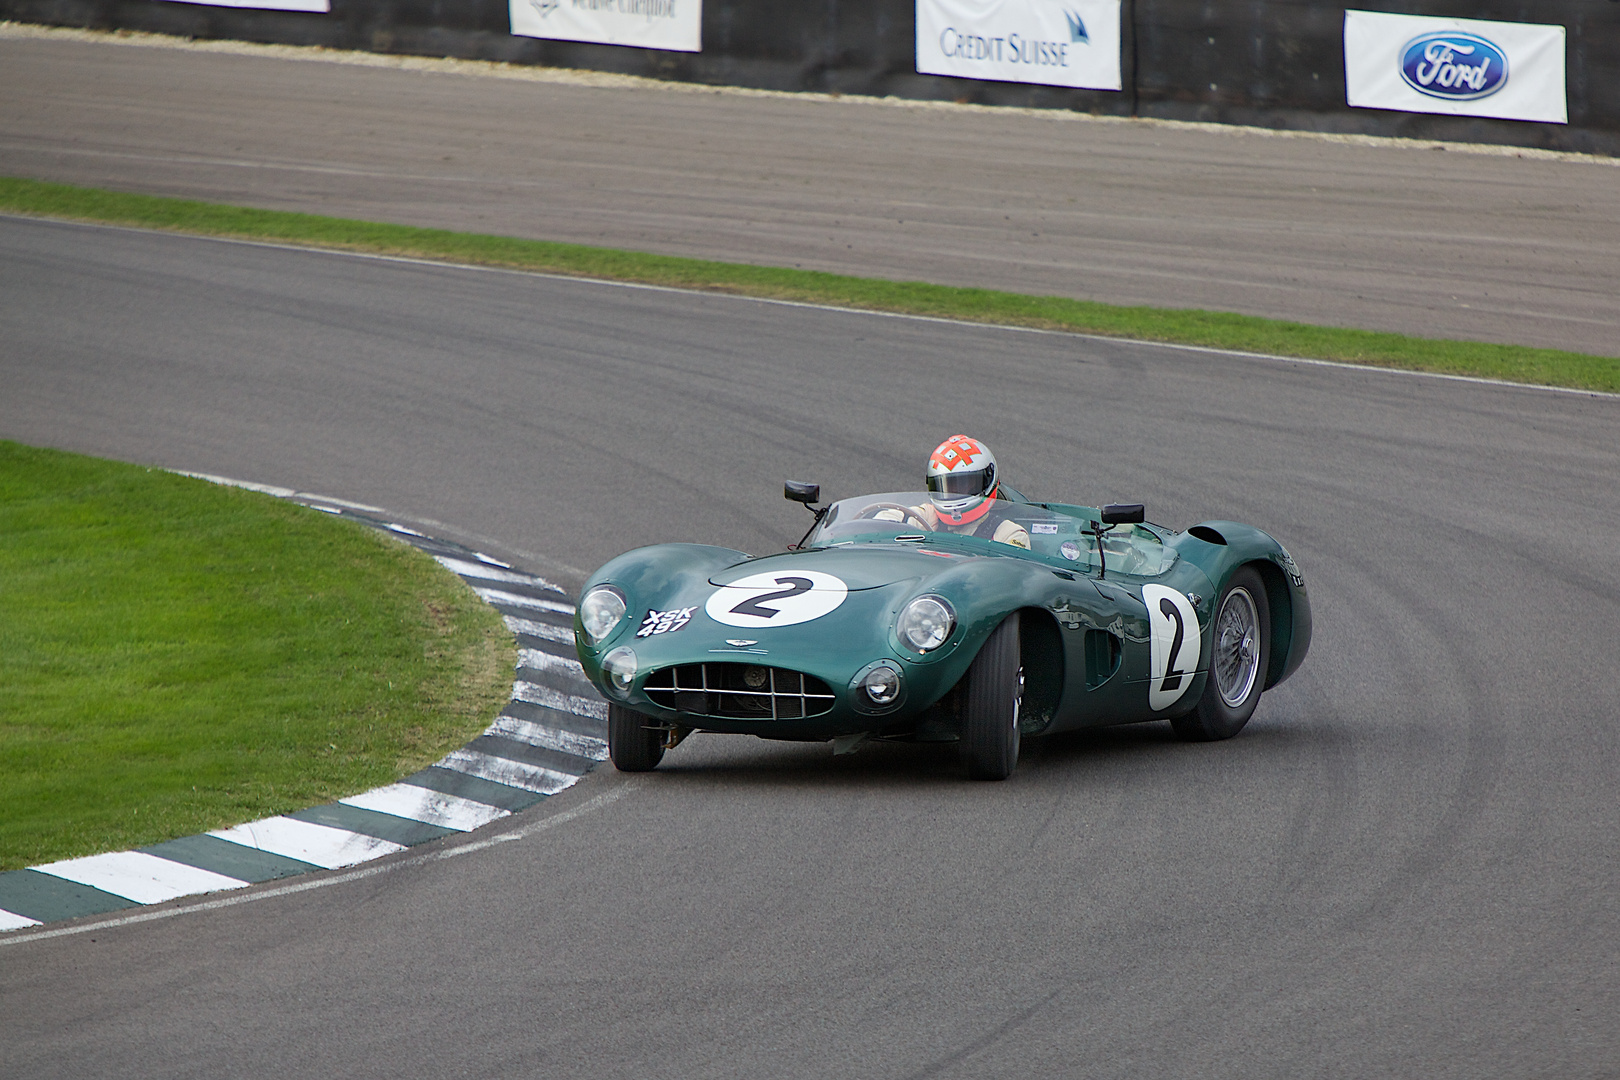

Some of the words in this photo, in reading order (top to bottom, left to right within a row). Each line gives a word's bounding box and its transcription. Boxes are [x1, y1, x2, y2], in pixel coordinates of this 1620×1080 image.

[939, 27, 1004, 62] CREDIT
[1007, 33, 1069, 67] SUISSE
[1416, 40, 1491, 91] Ford
[642, 606, 699, 625] XSK
[728, 576, 814, 618] 2
[636, 618, 690, 637] 497
[1159, 597, 1184, 692] 2
